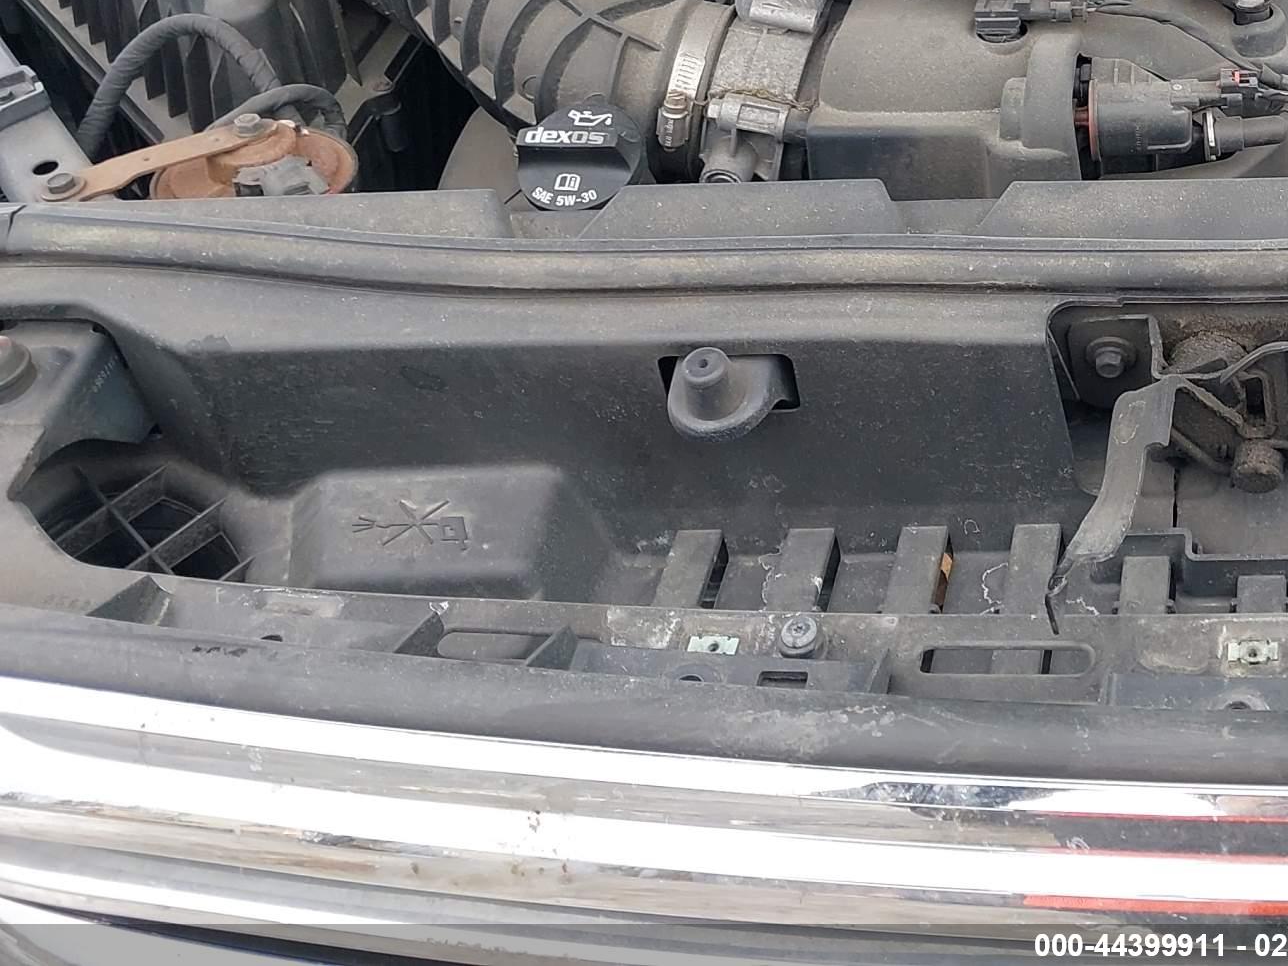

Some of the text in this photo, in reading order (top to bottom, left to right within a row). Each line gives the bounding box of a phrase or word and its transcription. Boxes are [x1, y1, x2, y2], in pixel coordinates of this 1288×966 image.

[525, 127, 605, 145] dexos
[532, 187, 597, 206] SAE 5W-30
